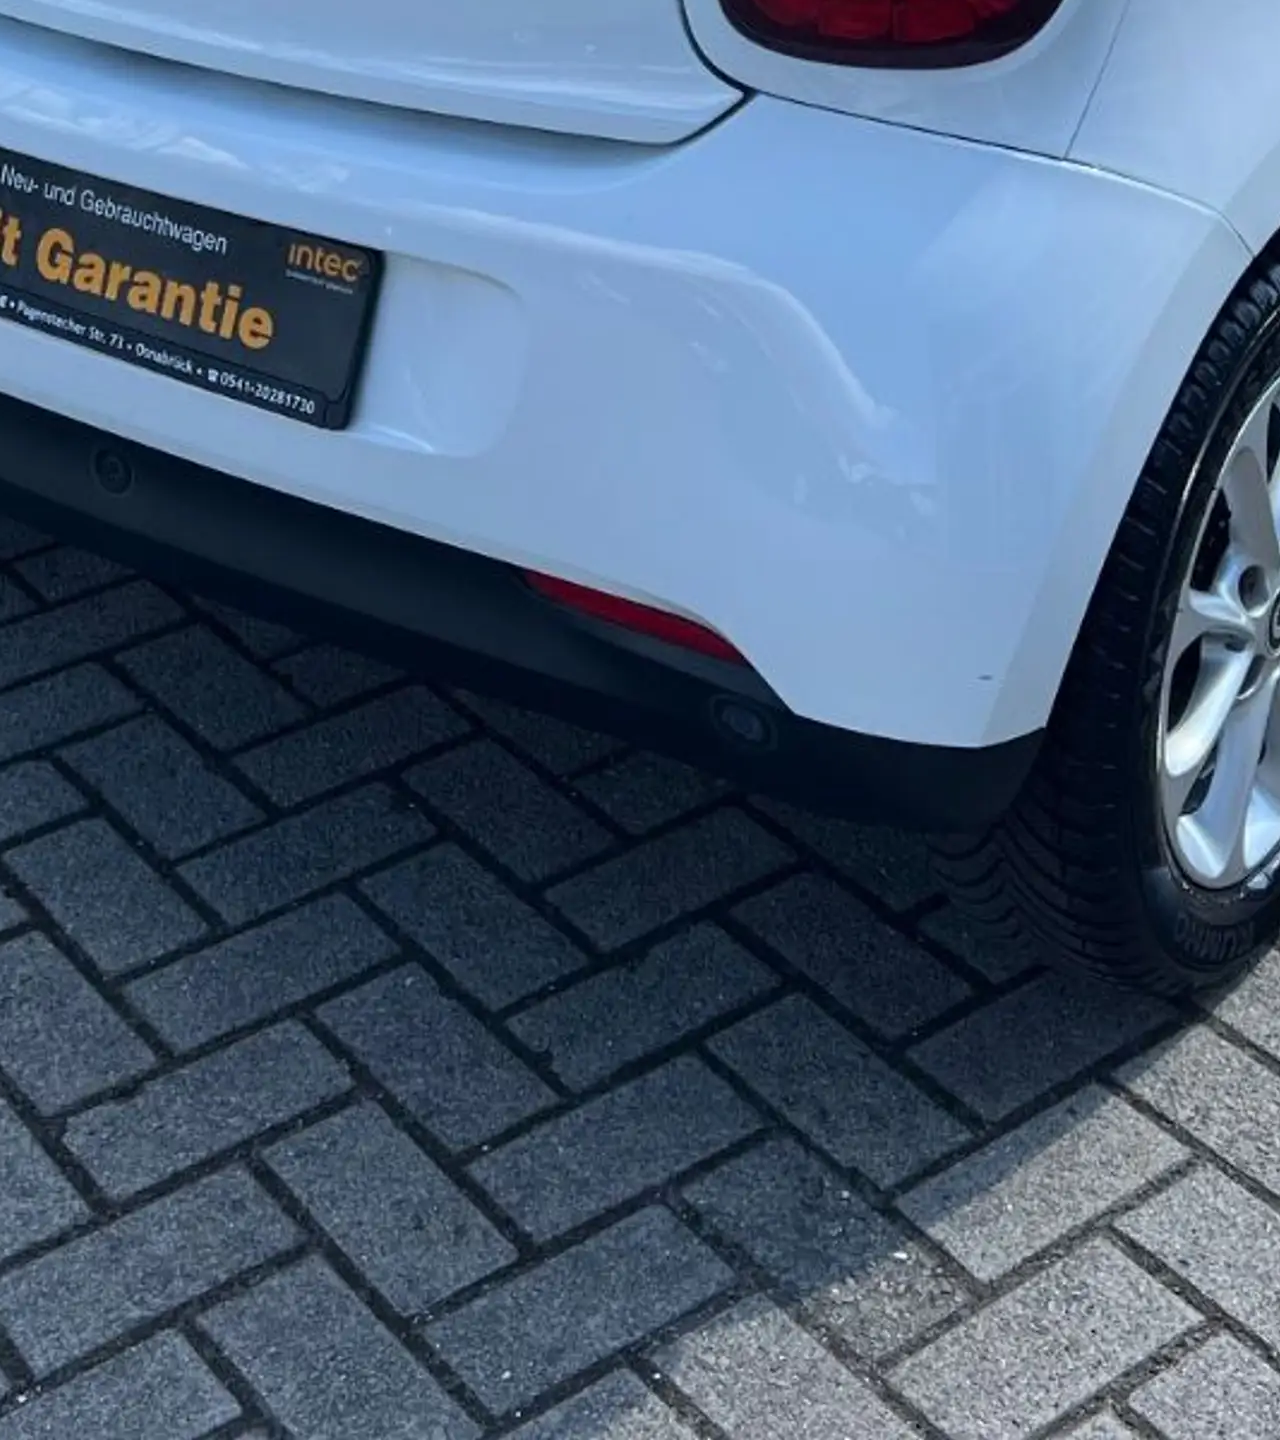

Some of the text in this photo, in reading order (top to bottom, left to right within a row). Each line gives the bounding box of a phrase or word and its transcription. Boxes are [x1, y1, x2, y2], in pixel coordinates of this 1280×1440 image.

[0, 164, 227, 255] Neu- und Gebrauchtwagen
[36, 227, 275, 350] Garantie
[287, 243, 362, 282] intec
